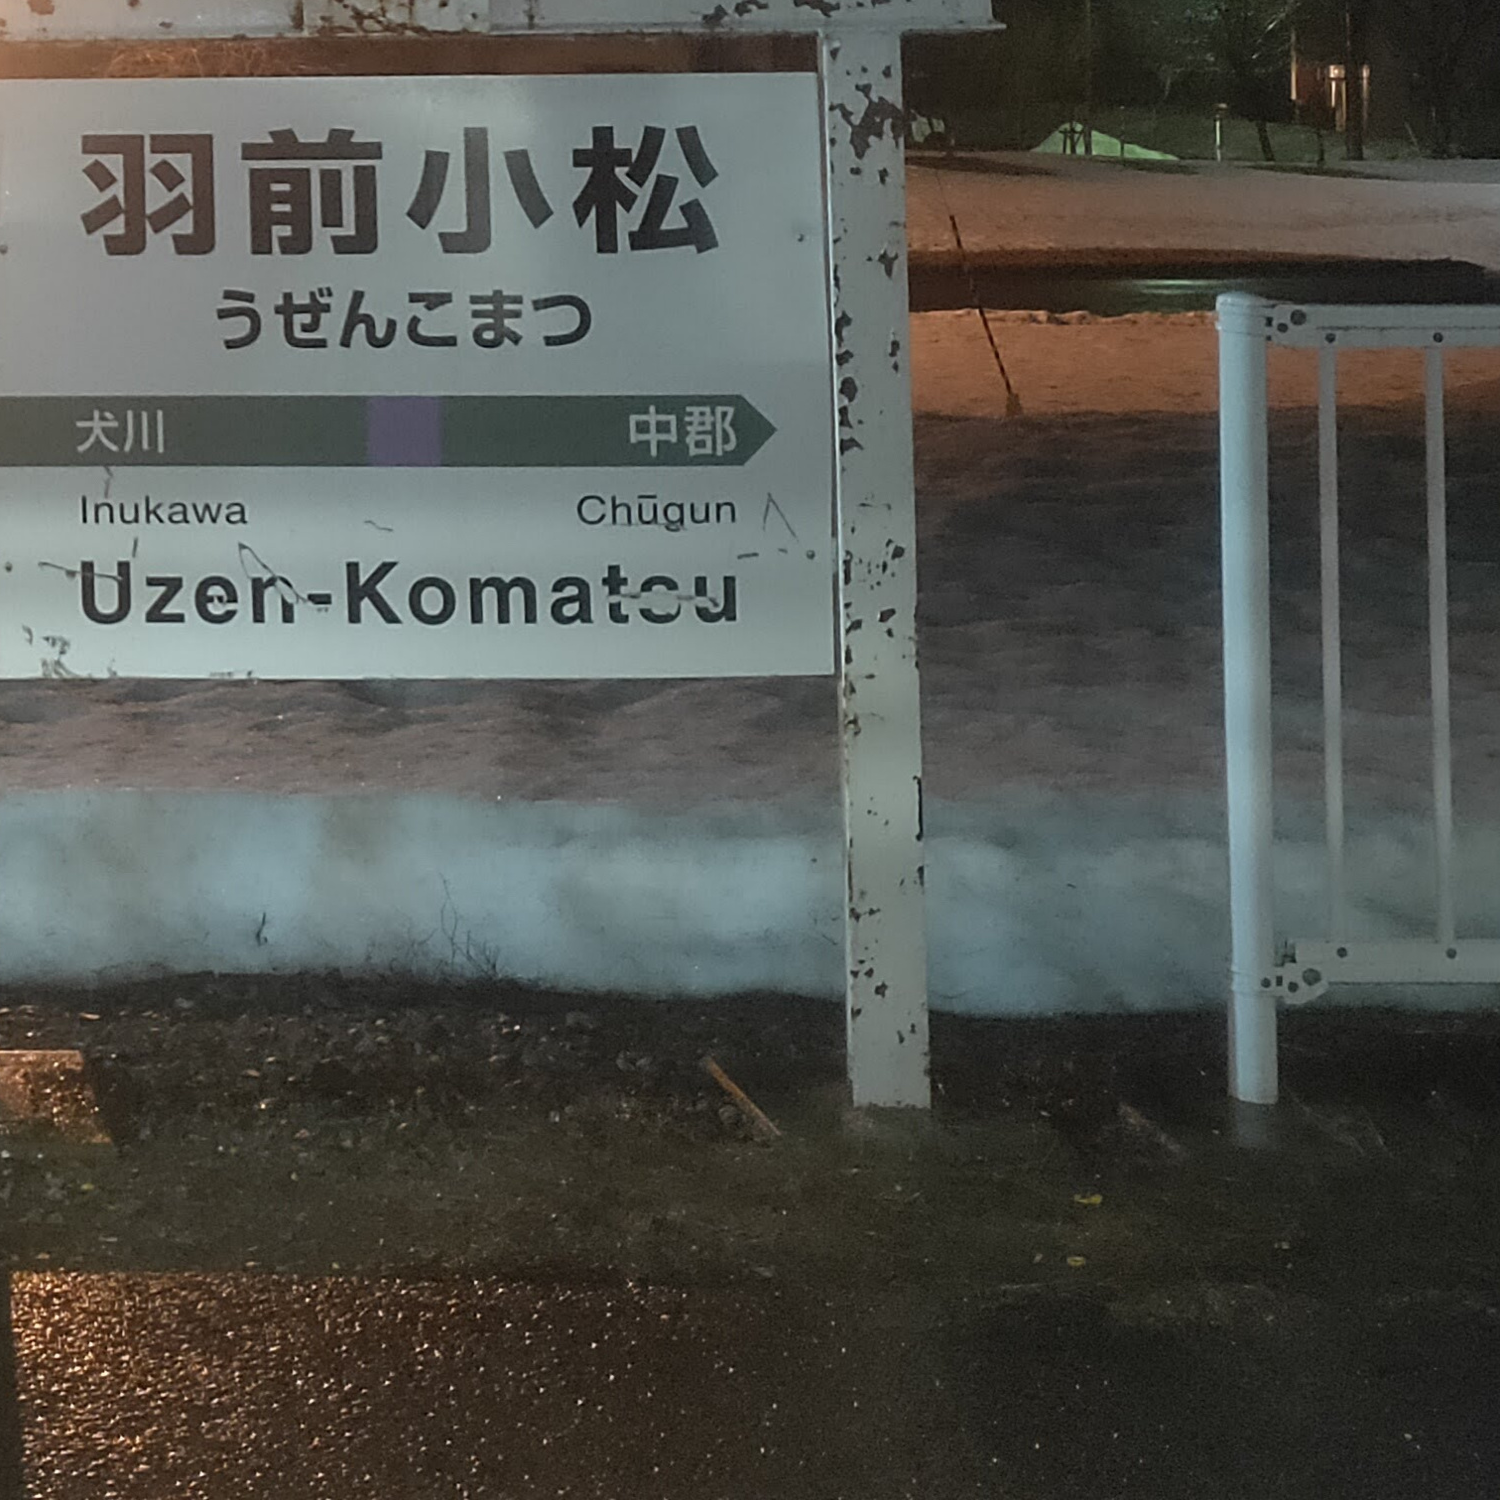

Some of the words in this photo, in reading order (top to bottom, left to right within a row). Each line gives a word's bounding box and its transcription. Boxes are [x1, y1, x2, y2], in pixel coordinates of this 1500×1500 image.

[81, 125, 719, 256] 羽前小松
[215, 287, 593, 350] うぜんこまつ
[75, 409, 166, 455] 犬川
[628, 405, 738, 458] 中郡
[80, 495, 249, 525] Inukawa
[576, 494, 737, 533] Chūgun
[79, 560, 739, 626] Uzen-Komatsu
